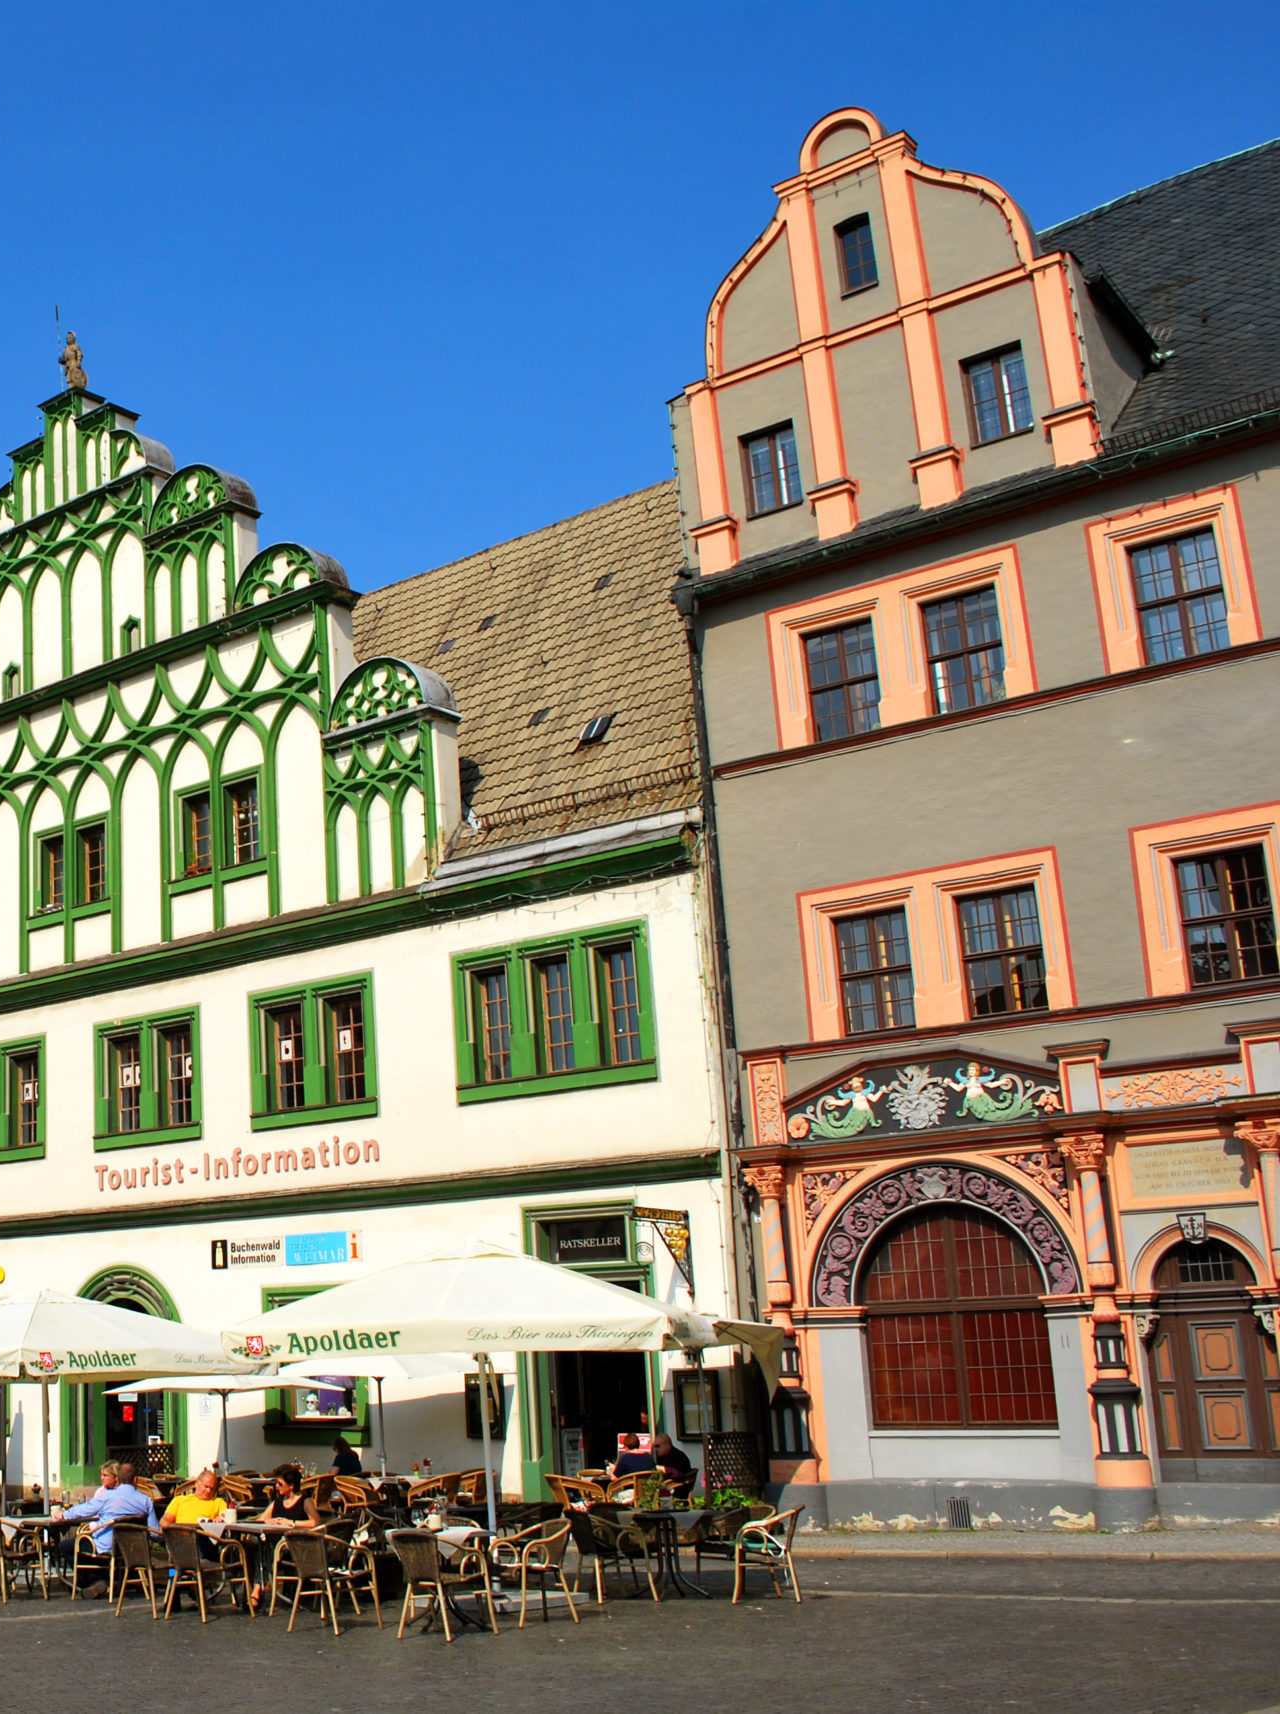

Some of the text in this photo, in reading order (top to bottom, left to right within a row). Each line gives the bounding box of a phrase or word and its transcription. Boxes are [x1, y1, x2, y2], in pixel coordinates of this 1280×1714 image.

[230, 1239, 281, 1253] Buchenwald
[559, 1236, 622, 1250] RATSKELLER
[230, 1253, 276, 1265] Information
[293, 1247, 345, 1263] WEIMAR
[287, 1329, 401, 1355] Apoldaer
[467, 1324, 654, 1344] Das Bier aus Thüringen
[67, 1350, 137, 1370] Apoldaer
